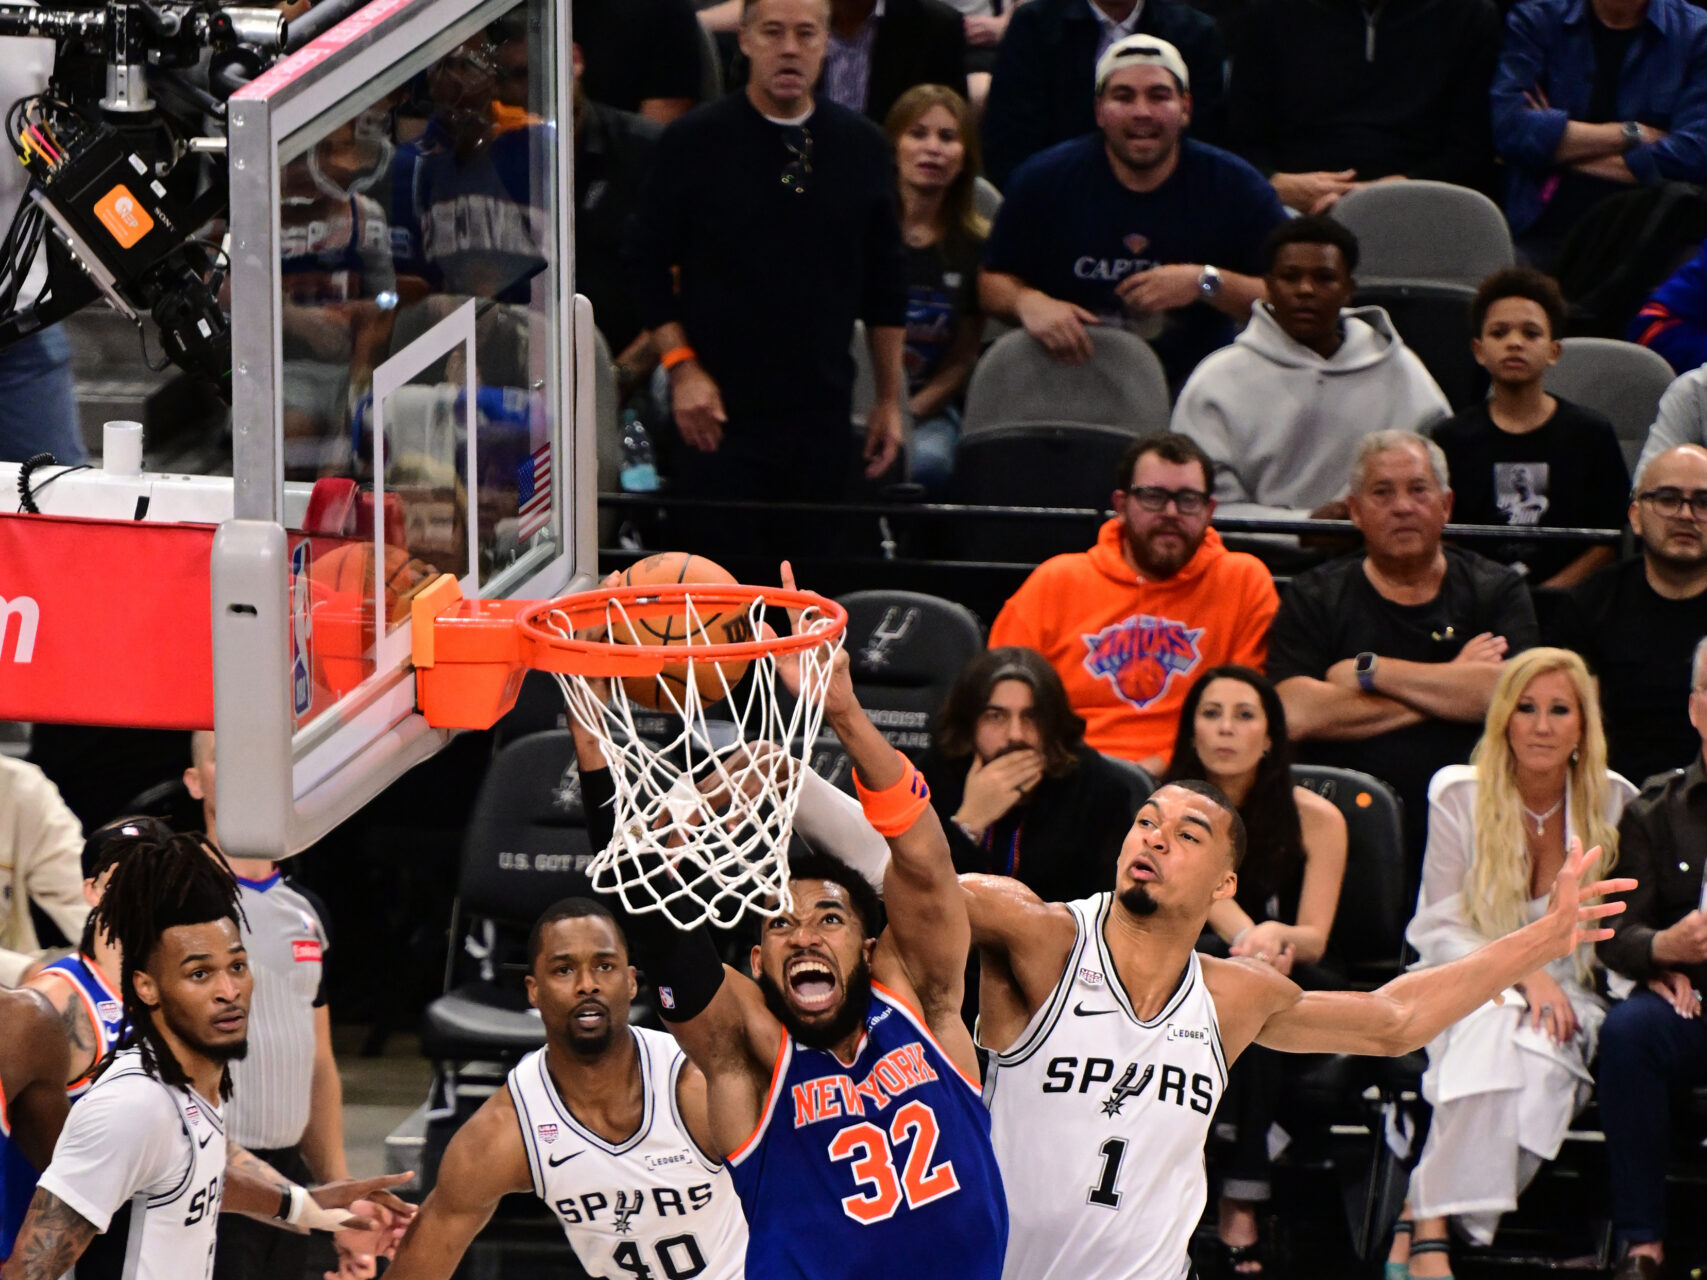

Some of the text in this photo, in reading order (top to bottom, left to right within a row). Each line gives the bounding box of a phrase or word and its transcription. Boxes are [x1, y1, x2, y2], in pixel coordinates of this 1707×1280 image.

[153, 207, 175, 232] SONY
[1073, 256, 1160, 280] CAPT
[499, 851, 530, 871] U.S.
[534, 854, 571, 872] GOT
[1172, 1027, 1205, 1040] LEDGER
[791, 1041, 940, 1129] NEW YORK
[1042, 1056, 1213, 1119] SPURS
[651, 1154, 687, 1167] LEDGER
[827, 1099, 961, 1225] 32
[1086, 1136, 1130, 1210] 1
[555, 1182, 714, 1235] SPURS
